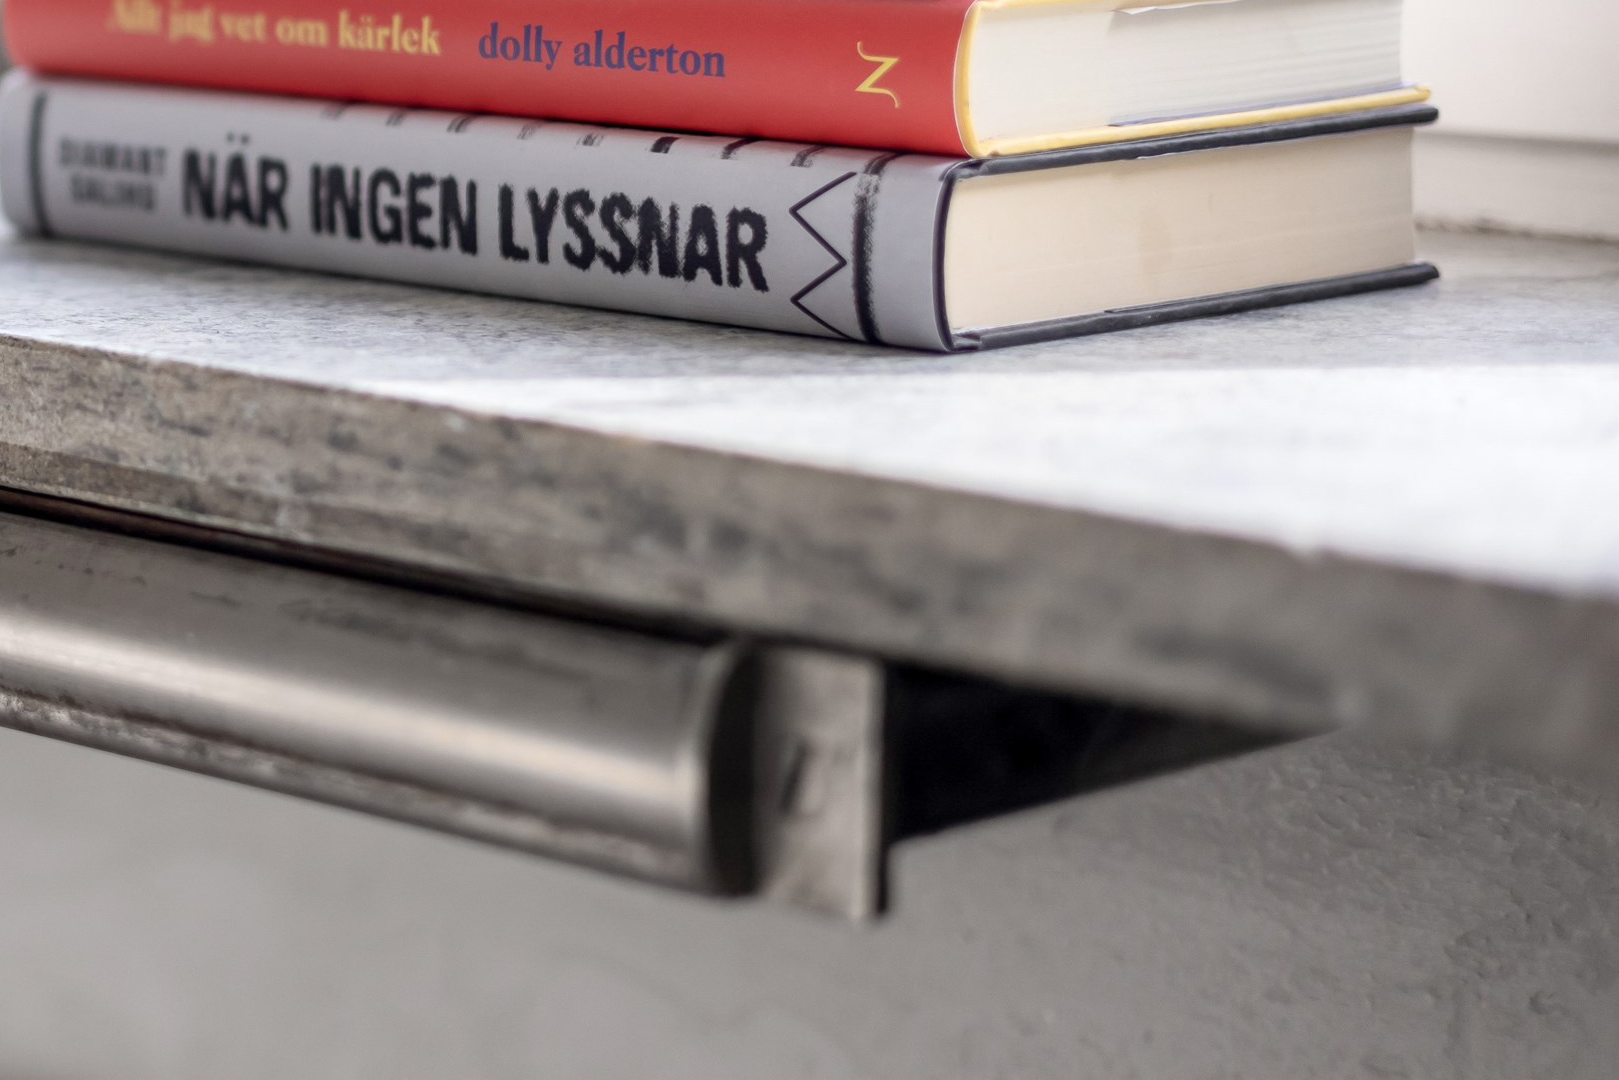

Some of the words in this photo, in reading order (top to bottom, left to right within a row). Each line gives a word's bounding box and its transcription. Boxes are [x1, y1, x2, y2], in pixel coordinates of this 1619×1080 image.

[219, 11, 267, 44] vet
[275, 17, 329, 48] om
[337, 8, 441, 57] kärlek
[478, 21, 563, 71] dolly
[573, 29, 726, 78] alderton
[183, 131, 289, 232] NÄR
[310, 162, 478, 257] INGEN
[496, 182, 770, 293] LYSSNAR
